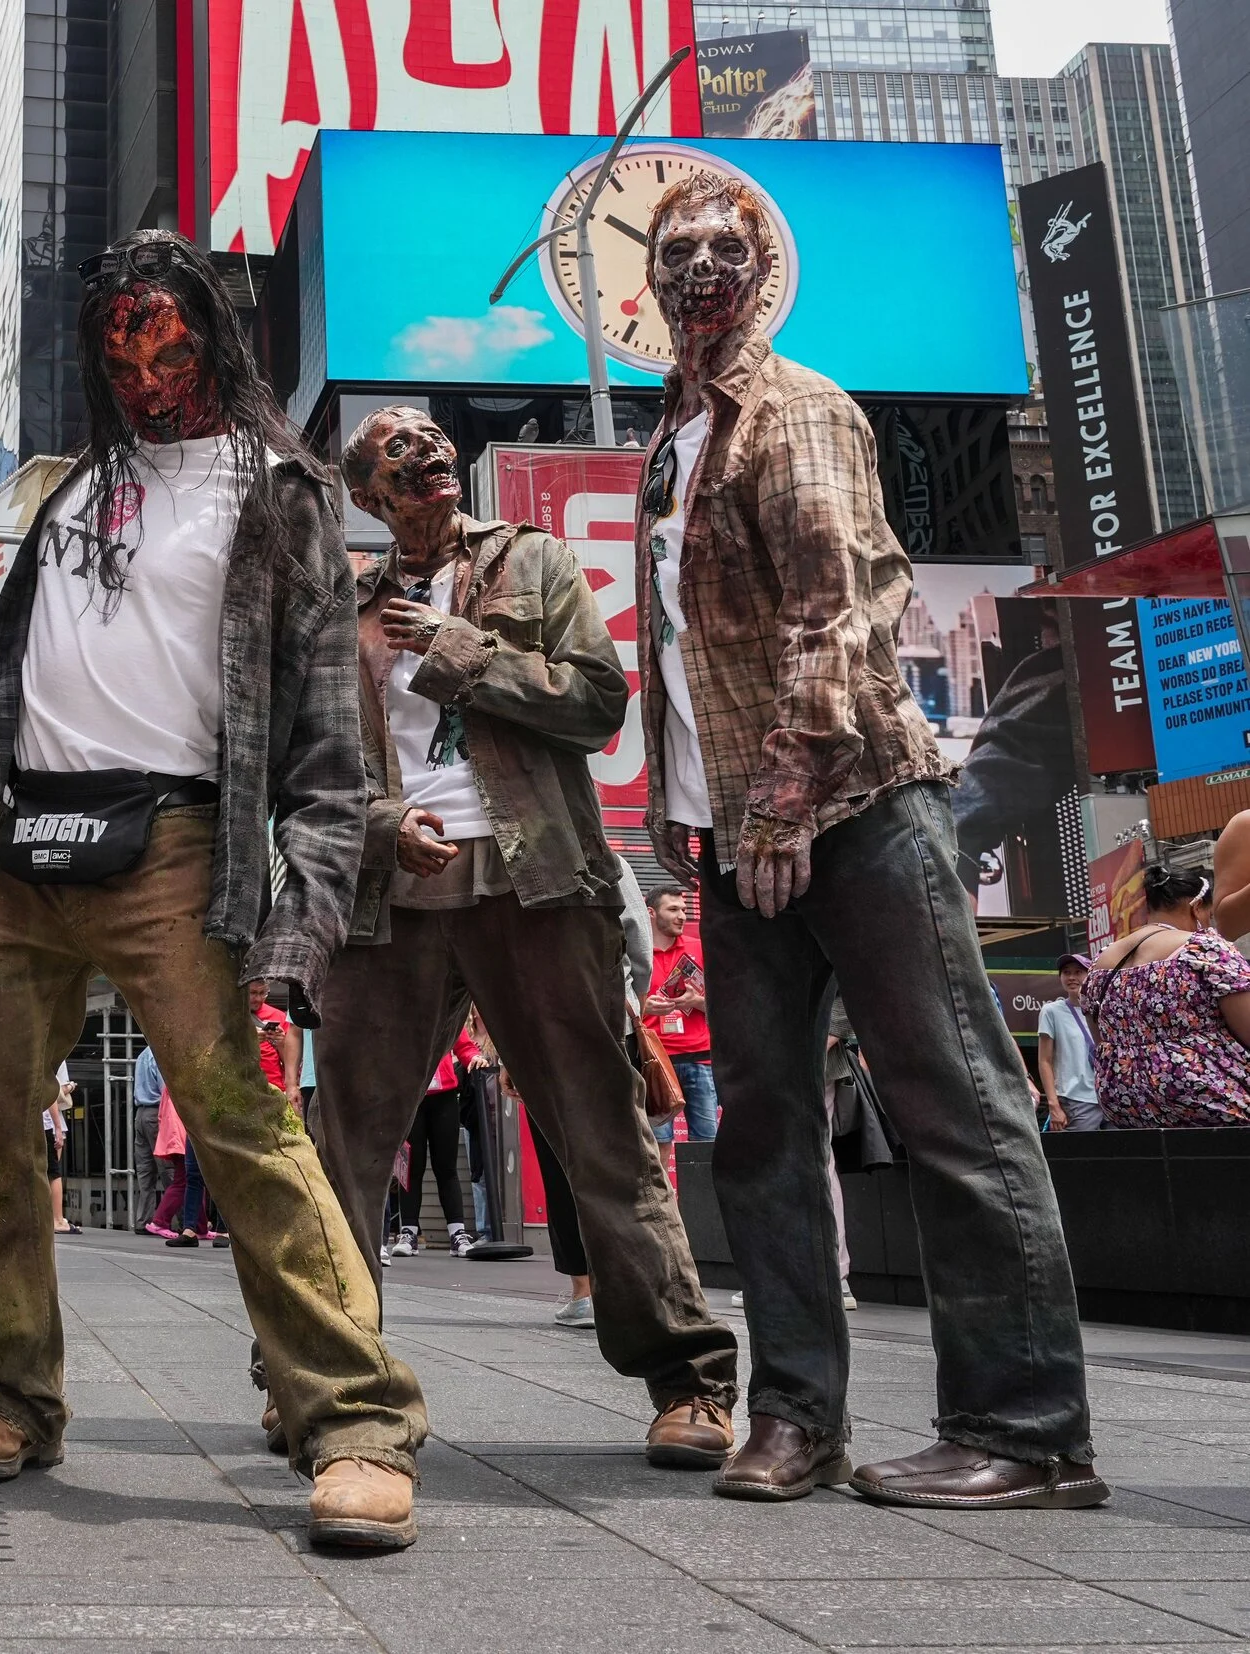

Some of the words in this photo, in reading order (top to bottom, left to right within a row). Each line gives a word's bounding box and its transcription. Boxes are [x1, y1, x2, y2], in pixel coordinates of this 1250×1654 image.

[698, 65, 767, 98] Potter
[703, 103, 741, 114] CHILD
[1063, 288, 1114, 481] EXCELLENCE
[1088, 490, 1123, 558] FOR
[1153, 610, 1181, 629] JEWS
[1183, 601, 1211, 620] HAVE
[1155, 623, 1204, 648] DOUBLED
[1105, 620, 1143, 712] TEAM
[1158, 653, 1186, 673] DEAR
[1187, 647, 1213, 665] NEW
[1160, 670, 1199, 692] WORDS
[1202, 664, 1217, 679] DO
[1163, 690, 1203, 711] PLEASE
[1205, 682, 1233, 700] STOP
[1165, 714, 1188, 730] OUR
[1210, 769, 1248, 784] LAMAR
